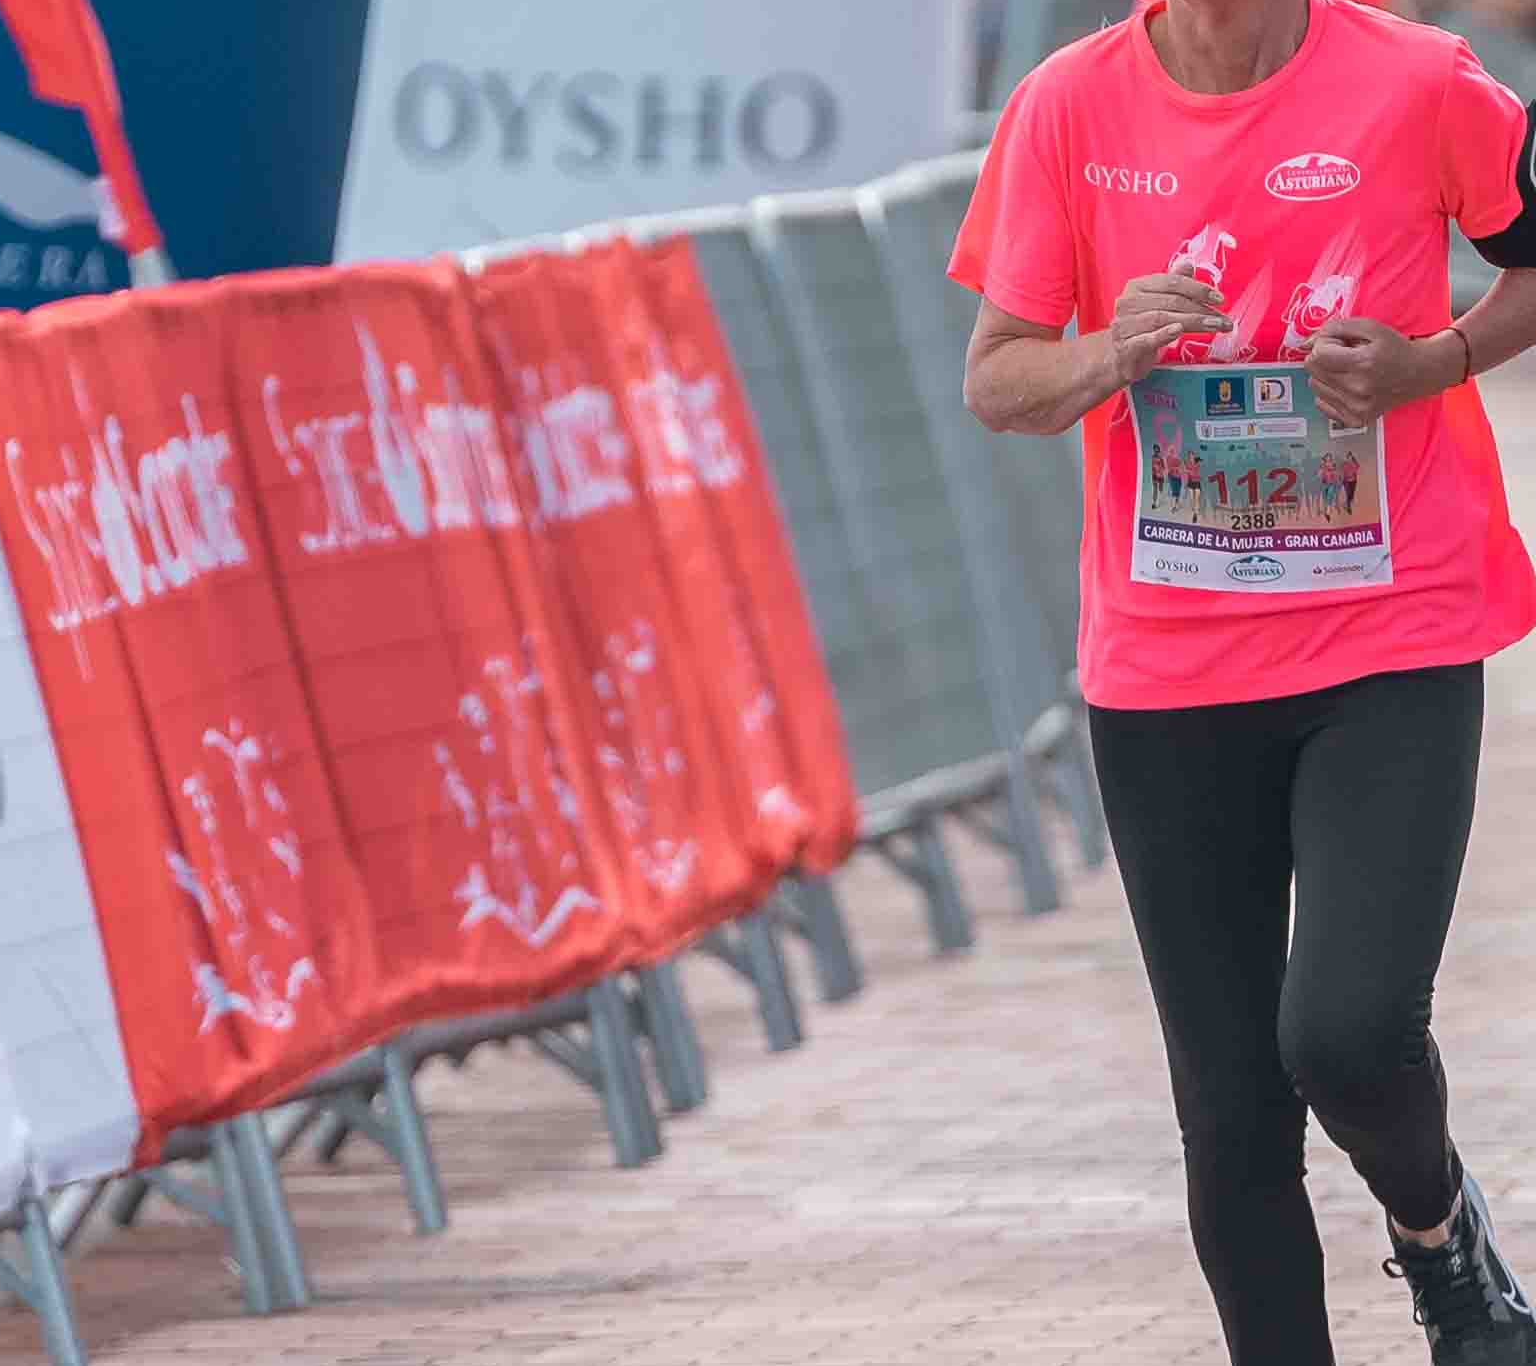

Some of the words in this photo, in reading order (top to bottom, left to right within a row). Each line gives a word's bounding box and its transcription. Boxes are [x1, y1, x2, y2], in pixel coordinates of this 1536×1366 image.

[392, 60, 840, 178] OYSHO
[1084, 162, 1179, 196] OYSHO
[1272, 172, 1354, 191] ASTURIANA
[1208, 467, 1298, 506] 112
[1230, 513, 1276, 531] 2388
[1144, 525, 1194, 544] CARRERA
[1197, 532, 1213, 547] DE
[1215, 535, 1231, 549] LA
[1231, 536, 1274, 550] MUJER
[1285, 535, 1319, 548] GRAN
[1322, 530, 1375, 547] CANARIA
[1155, 558, 1199, 574] OYSHO
